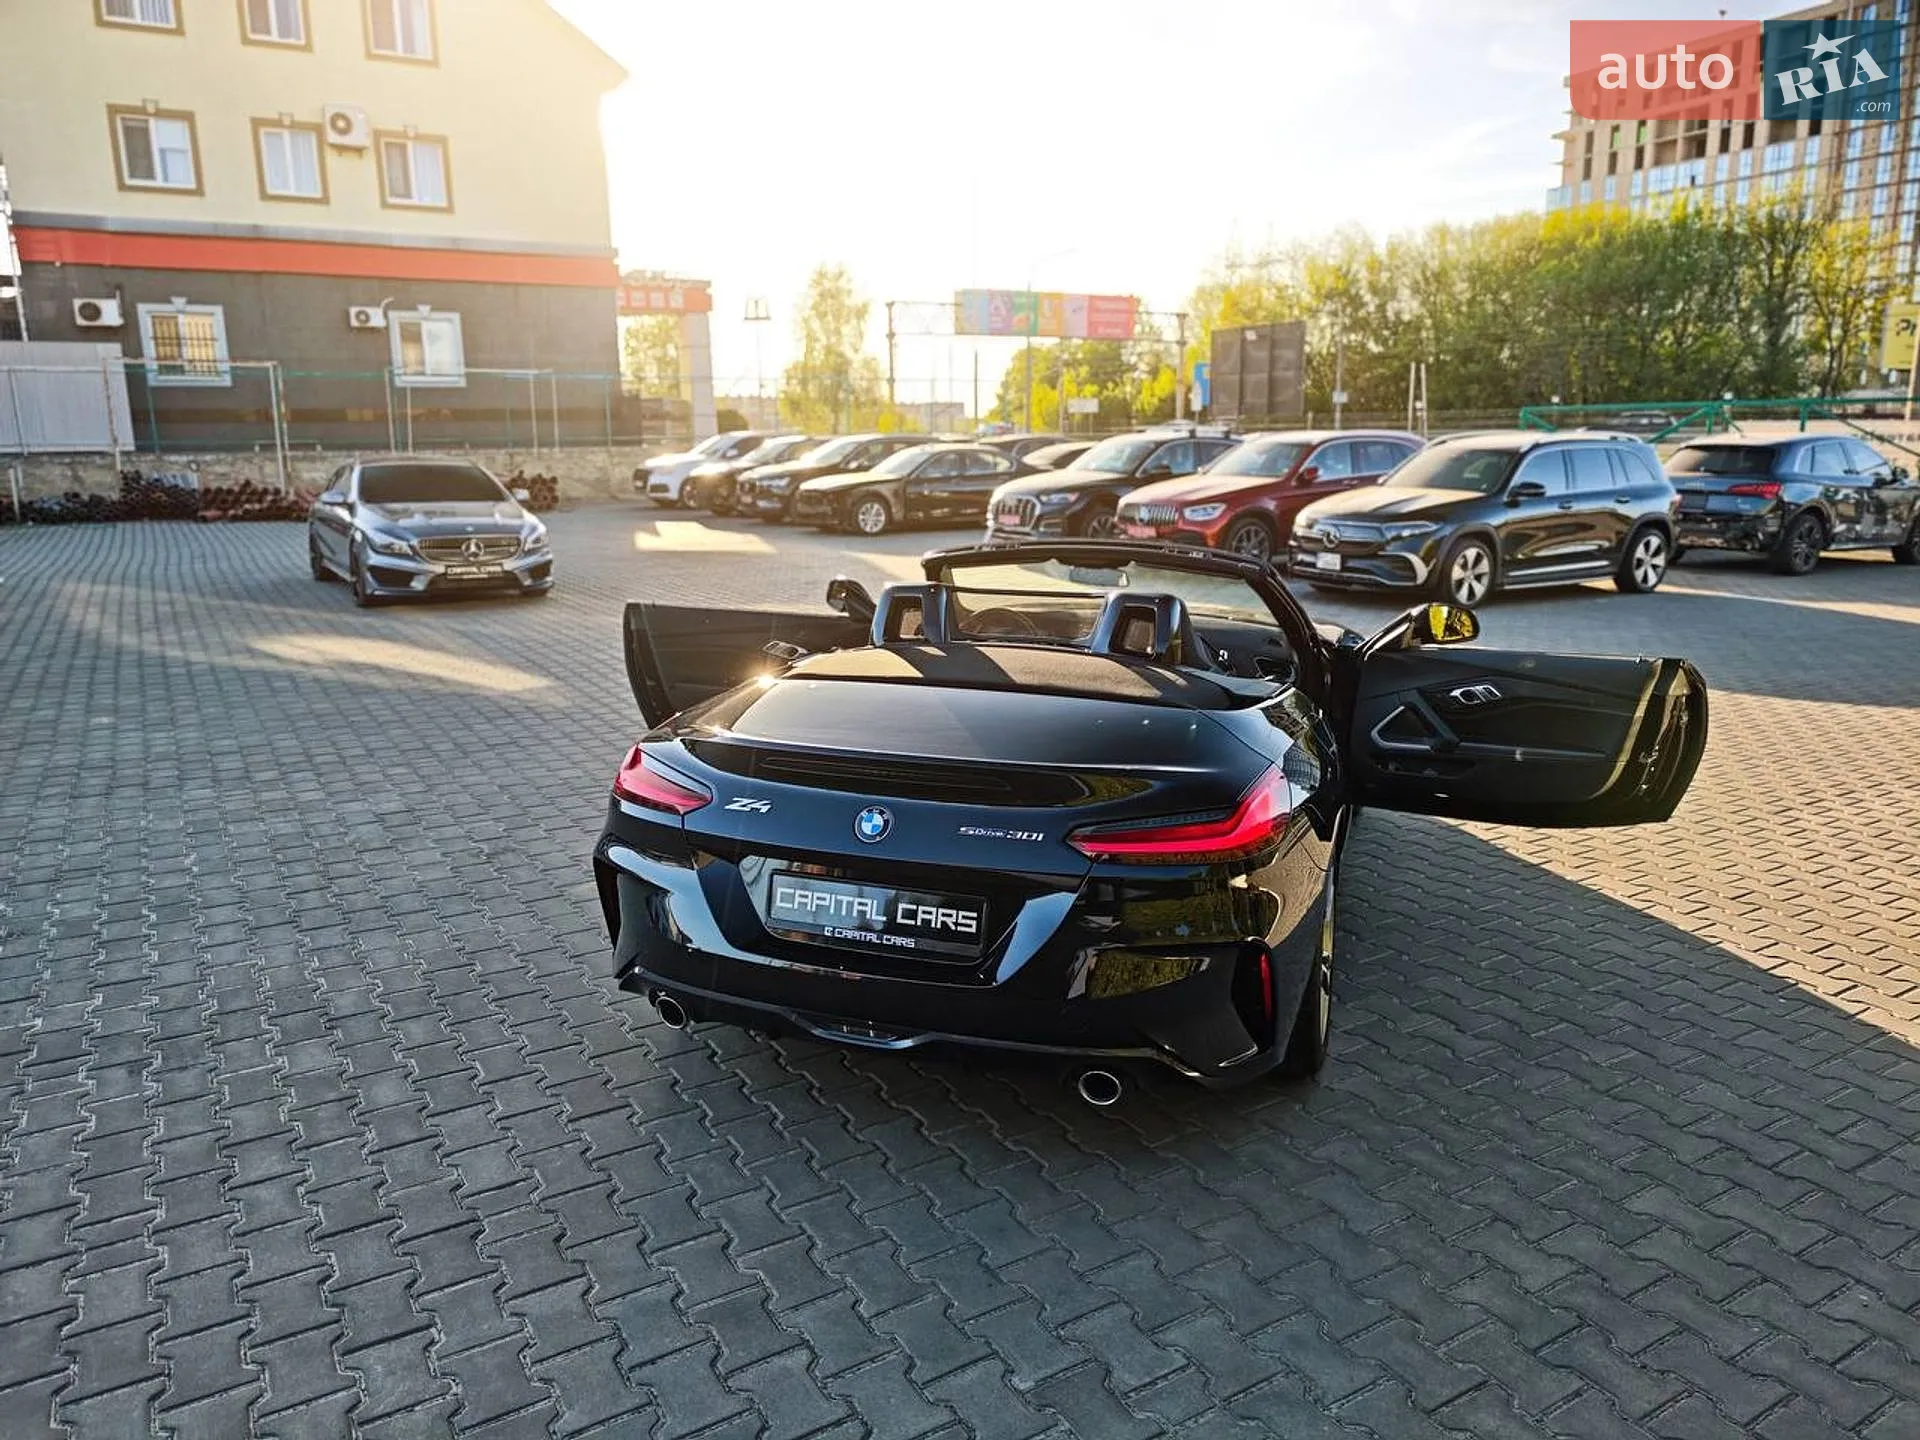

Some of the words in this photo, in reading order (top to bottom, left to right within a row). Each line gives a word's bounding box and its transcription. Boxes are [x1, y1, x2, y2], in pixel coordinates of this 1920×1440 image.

[724, 797, 771, 813] Z4
[776, 887, 887, 921] CAPITAL
[896, 902, 977, 933] CARS
[834, 928, 881, 943] CAPITAL
[882, 934, 915, 948] CARS
